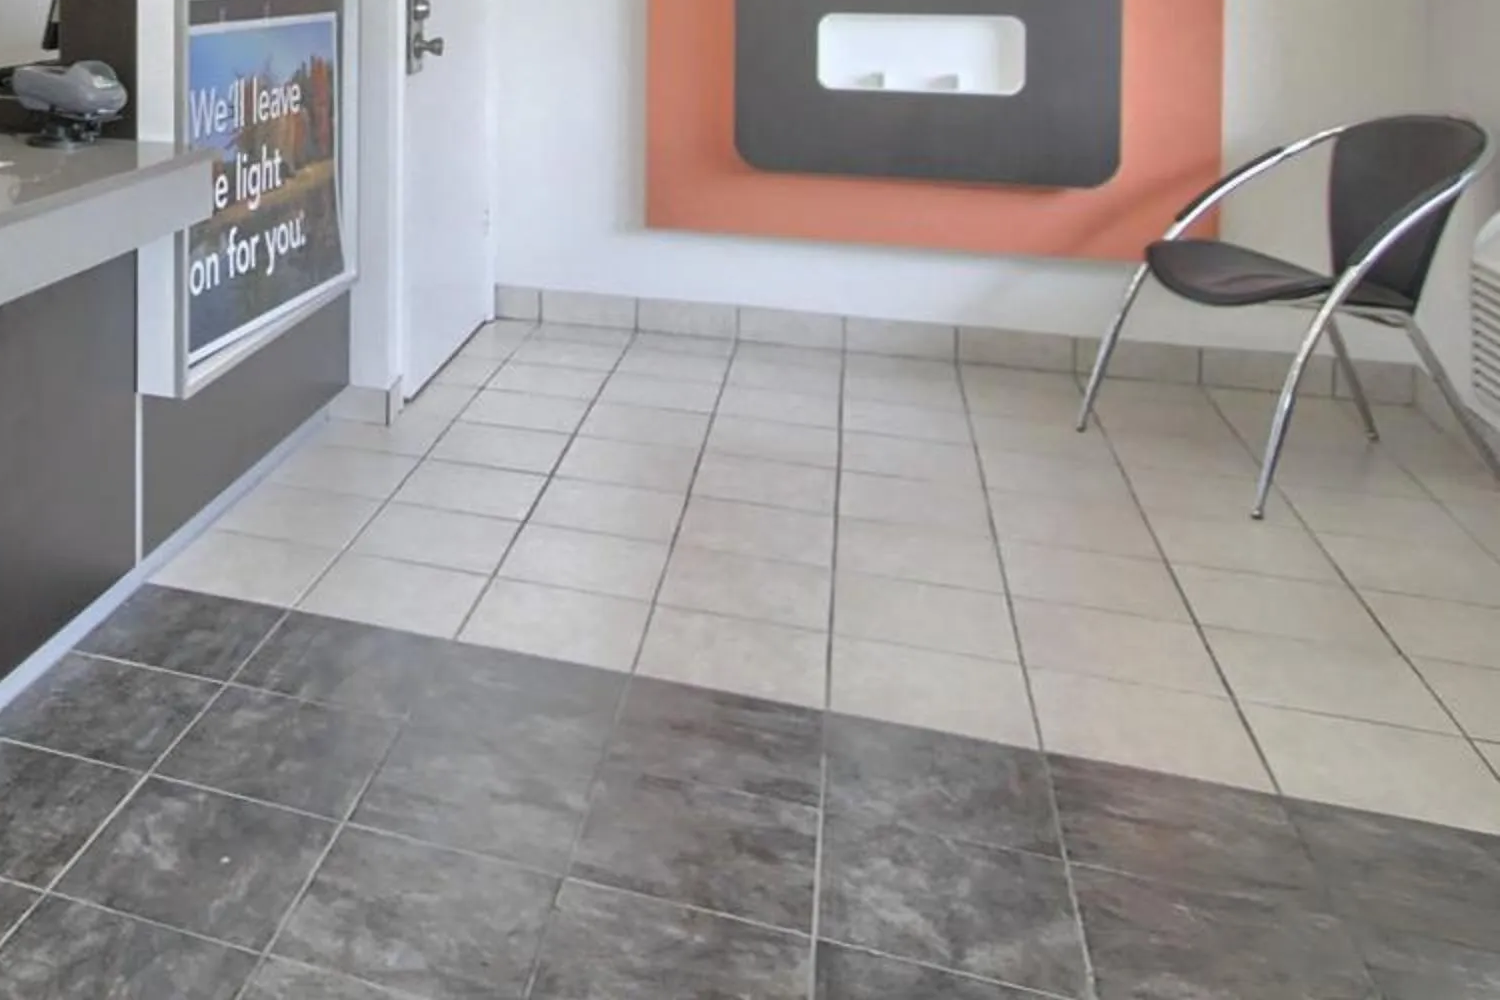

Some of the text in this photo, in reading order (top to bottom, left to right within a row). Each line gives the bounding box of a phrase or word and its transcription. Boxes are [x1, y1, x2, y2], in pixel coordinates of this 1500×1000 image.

[190, 76, 301, 139] We'll leave
[236, 144, 283, 210] light
[189, 218, 307, 296] on for you.
